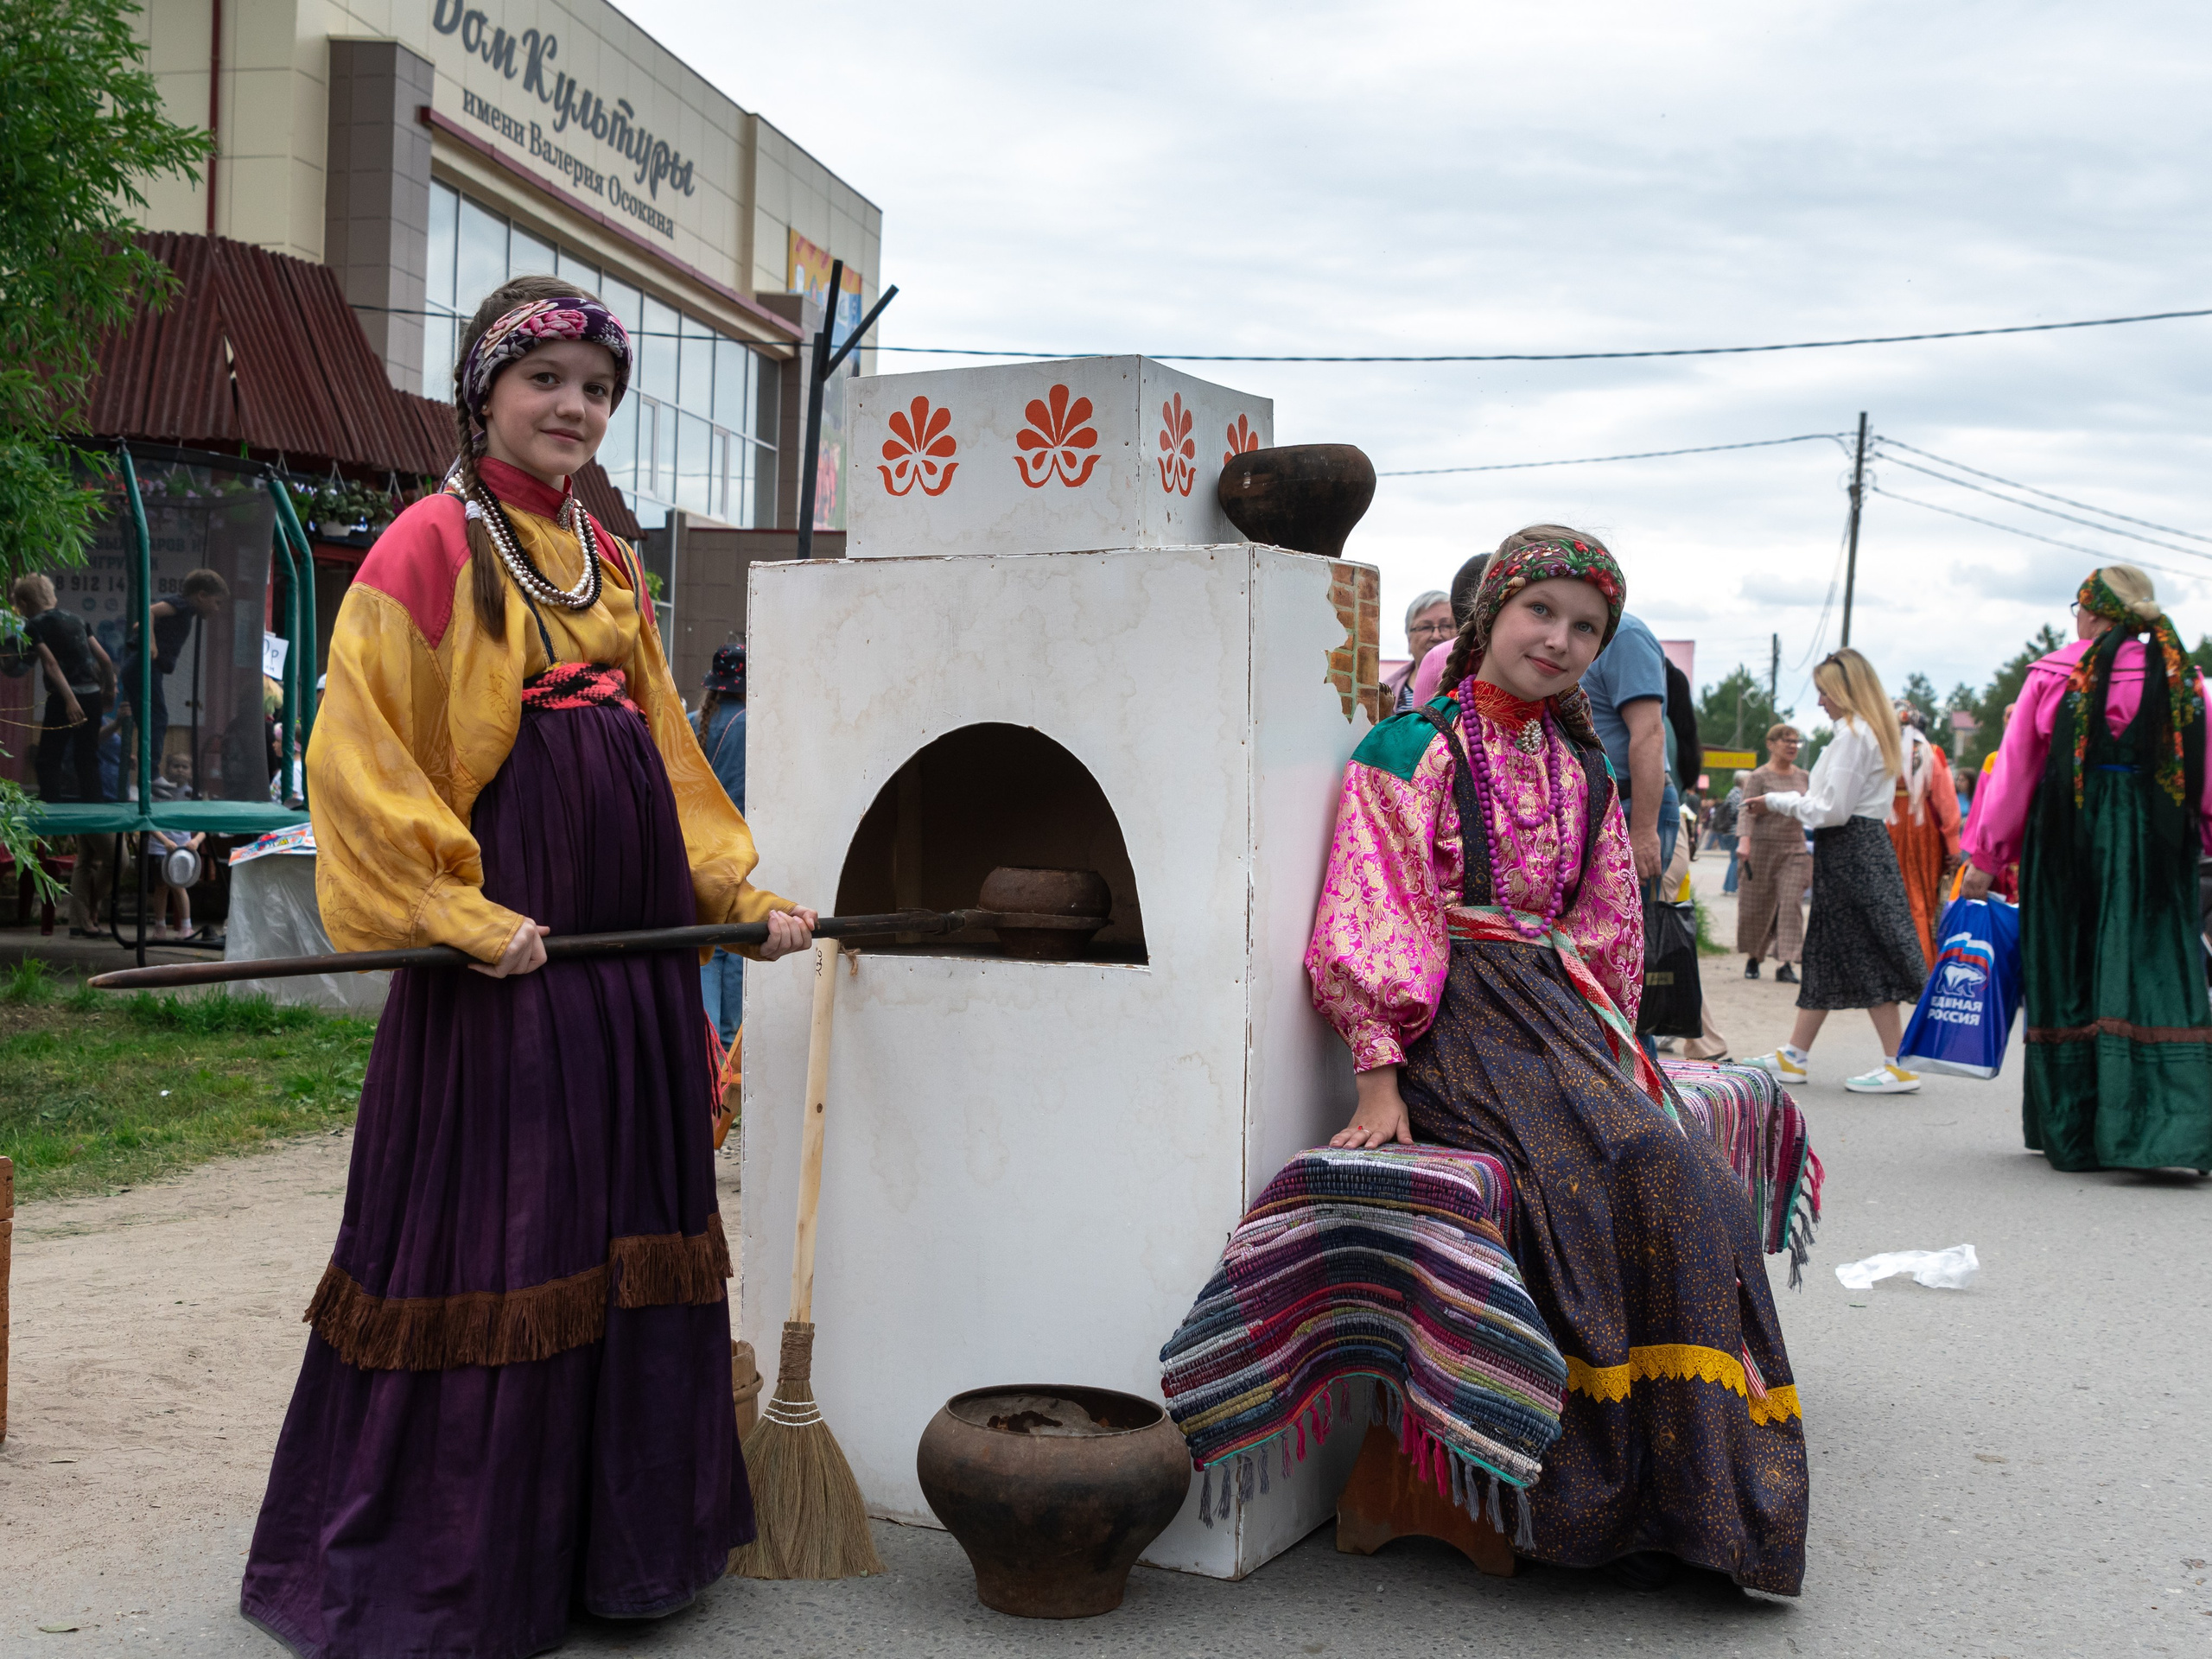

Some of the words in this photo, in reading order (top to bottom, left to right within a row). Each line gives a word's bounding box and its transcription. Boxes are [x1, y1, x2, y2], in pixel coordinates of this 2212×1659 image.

[521, 28, 696, 201] Культуры
[462, 87, 525, 148] имени
[529, 120, 604, 197] Валерия
[608, 175, 675, 240] Осокина
[71, 575, 99, 591] 912
[1927, 1008, 1980, 1026] РОССИЯ
